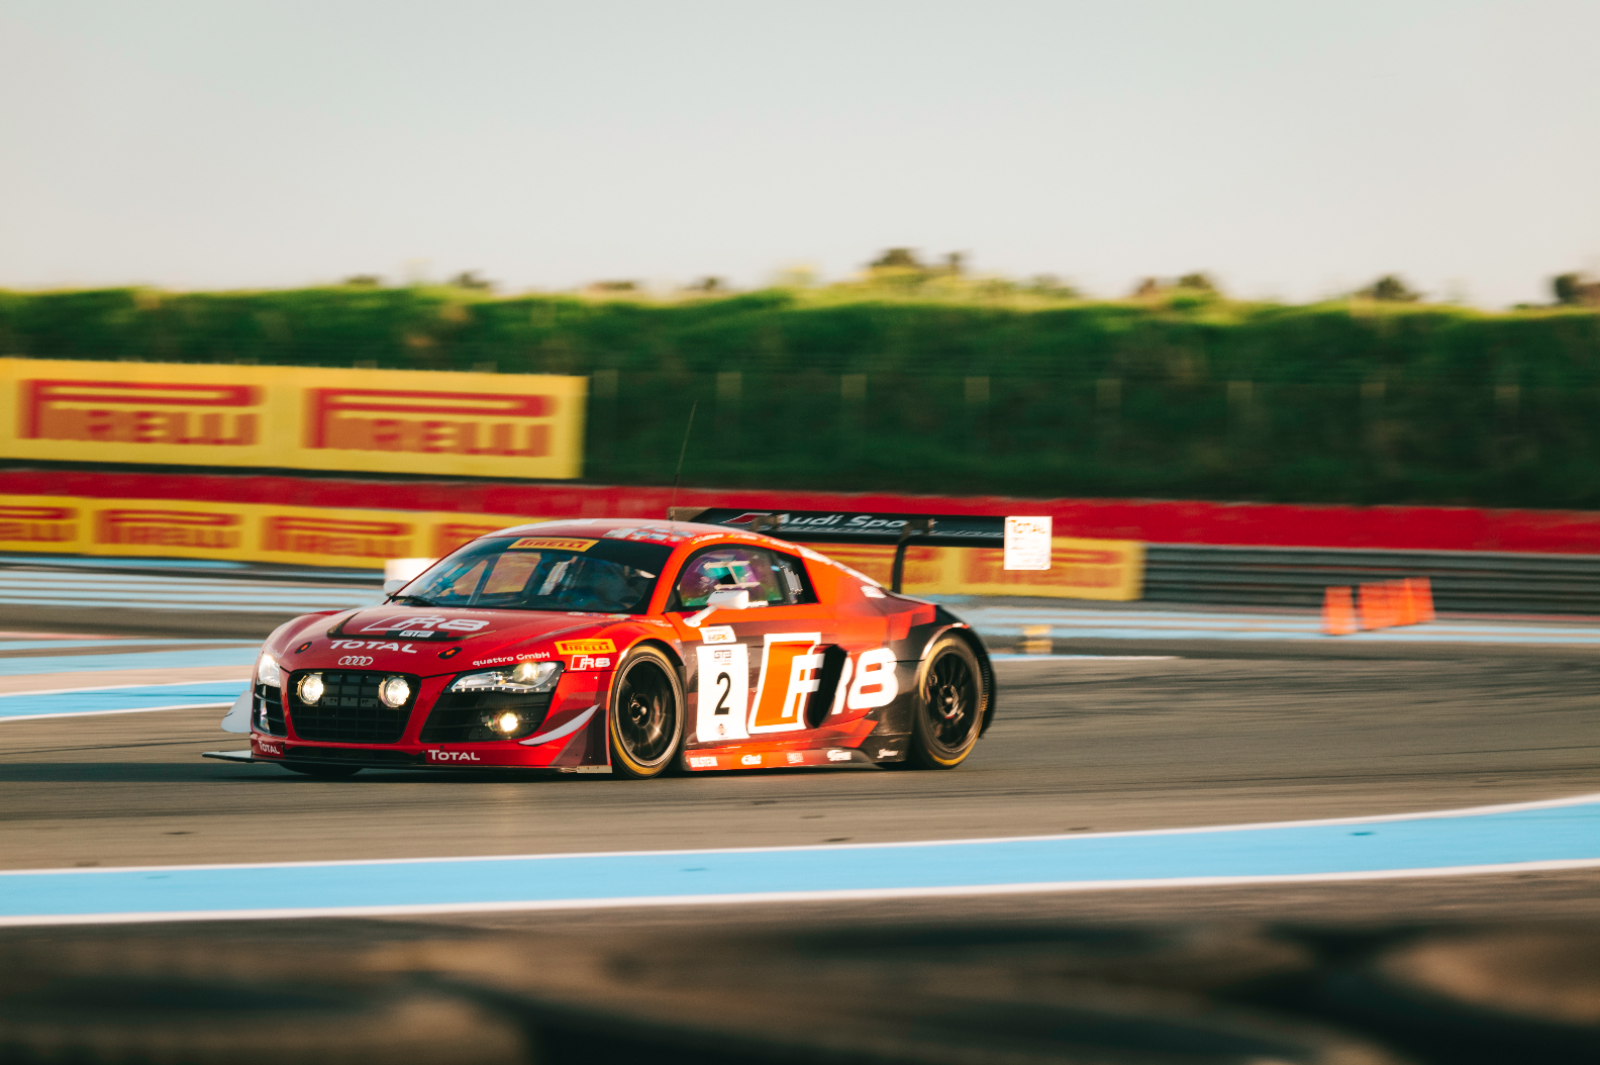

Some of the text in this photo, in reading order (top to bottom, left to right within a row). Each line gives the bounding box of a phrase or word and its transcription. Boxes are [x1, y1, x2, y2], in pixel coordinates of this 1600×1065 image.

[776, 512, 846, 526] Audi
[516, 538, 589, 549] PIRELLI
[391, 616, 490, 632] R8
[330, 639, 418, 654] TOTAL
[560, 641, 610, 652] PIRELLI
[472, 651, 551, 667] quattro GmbH
[580, 657, 611, 669] R8
[714, 671, 731, 716] 2
[258, 741, 281, 755] TOTAL
[428, 749, 481, 761] TOTAL
